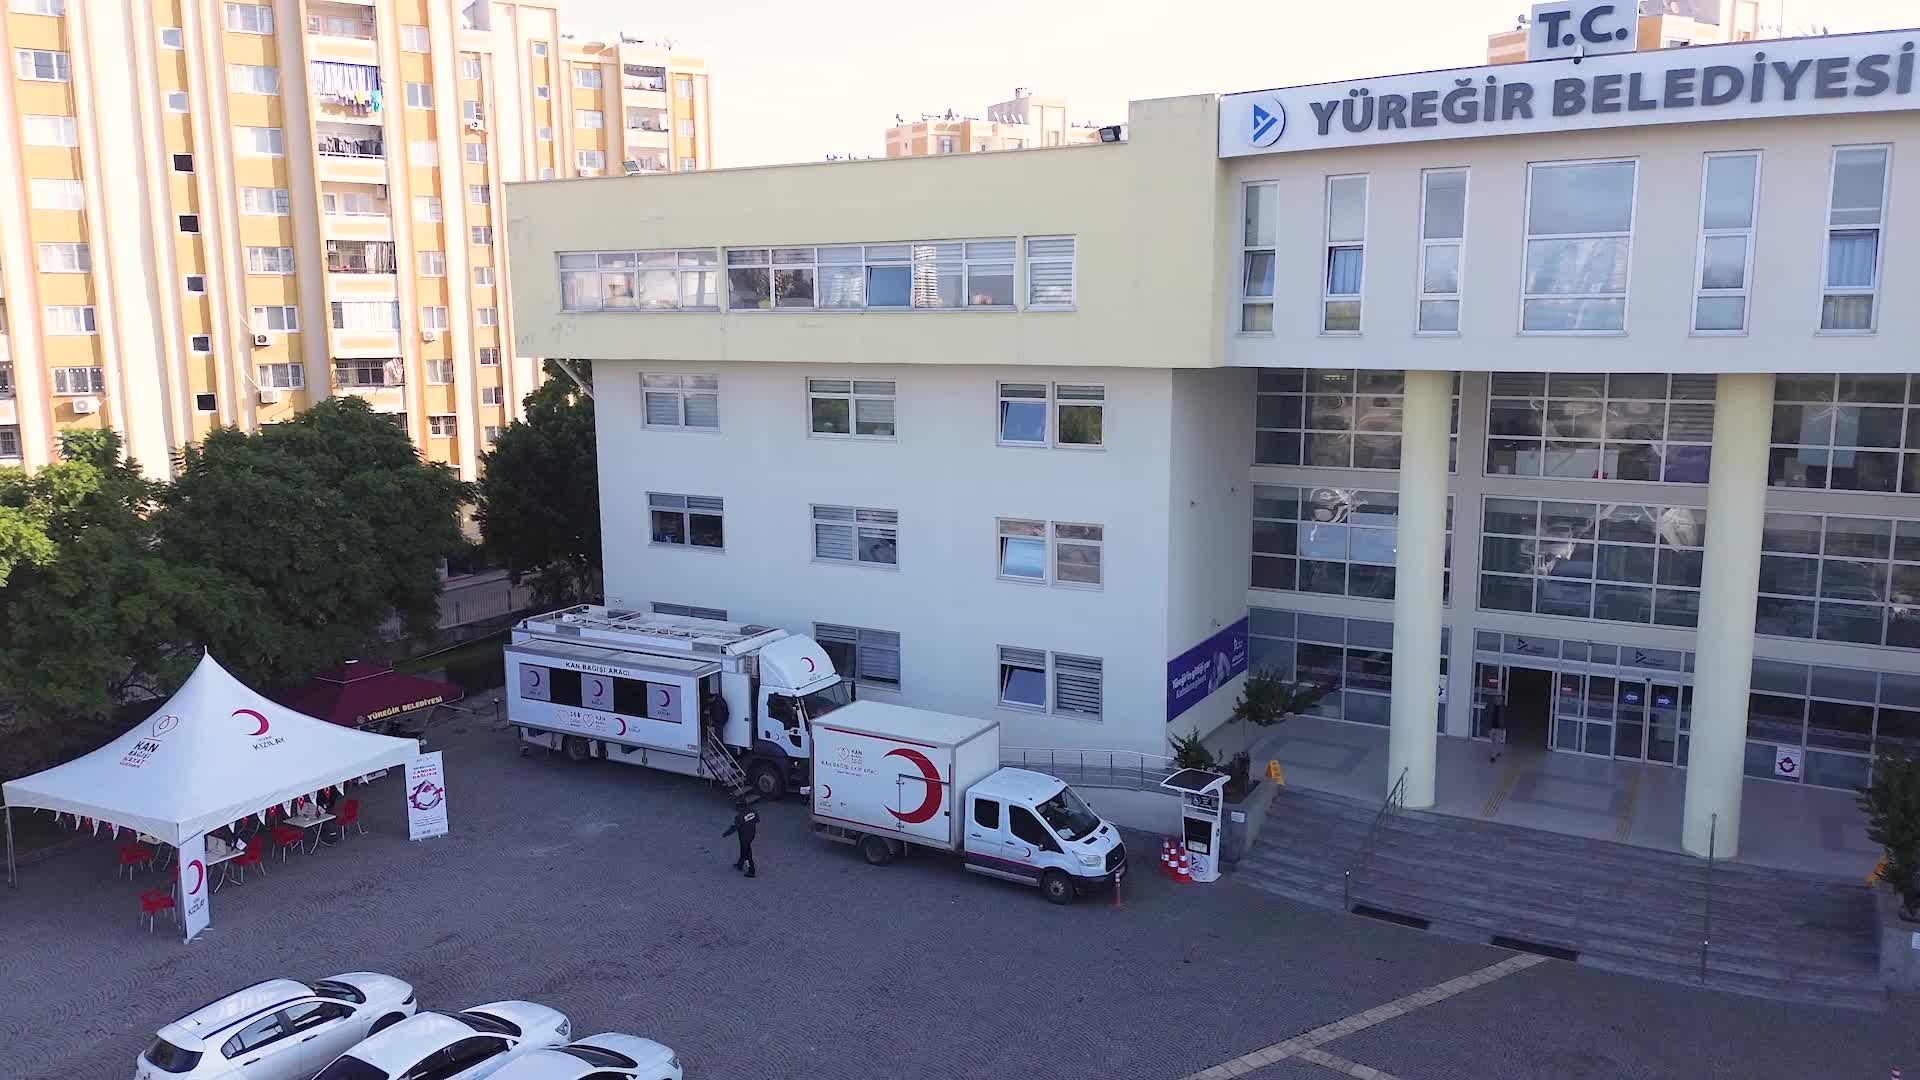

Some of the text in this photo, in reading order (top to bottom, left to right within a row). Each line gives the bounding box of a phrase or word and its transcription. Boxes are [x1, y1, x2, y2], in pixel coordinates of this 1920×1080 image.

[1539, 5, 1628, 48] T.C.
[1309, 41, 1915, 136] YÜREĞİR BELEDİYESİ
[565, 661, 581, 669] KAN
[367, 695, 443, 721] YÜREĞİR BELEDİYESİ
[133, 741, 160, 753] KAN
[252, 737, 286, 751] KIZILAY
